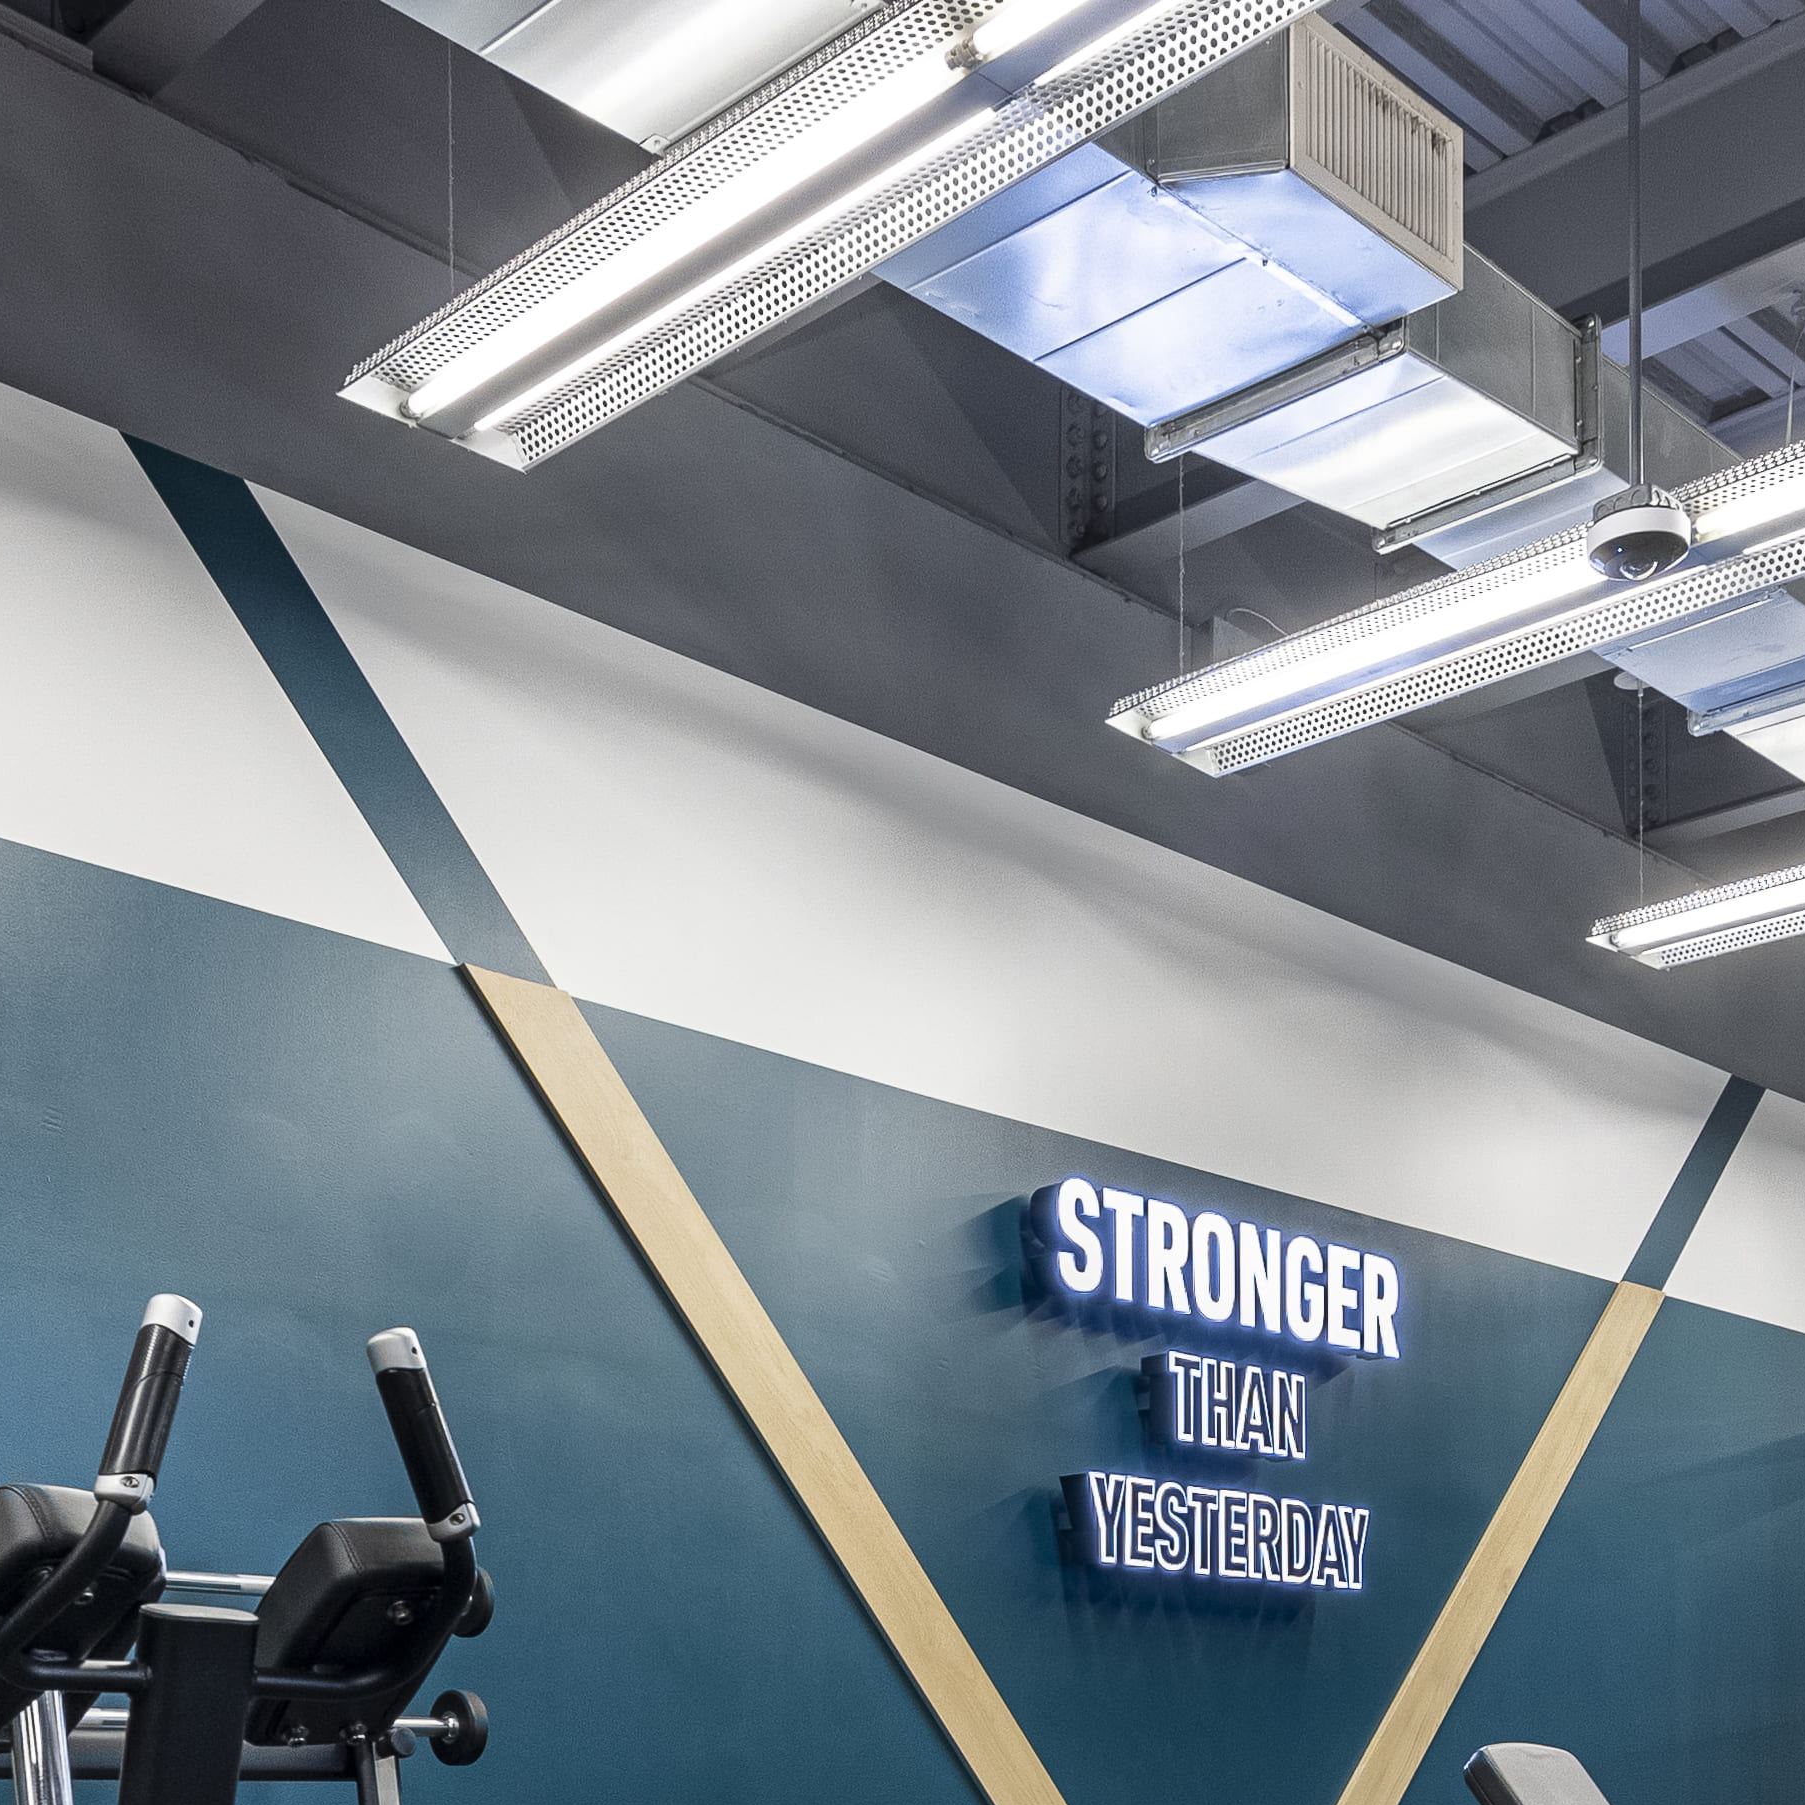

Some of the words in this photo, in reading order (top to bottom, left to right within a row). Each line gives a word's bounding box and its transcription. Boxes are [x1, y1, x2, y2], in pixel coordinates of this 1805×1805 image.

[1056, 1178, 1400, 1358] STRONGER
[1169, 1350, 1306, 1459] THAN
[1089, 1471, 1370, 1589] YESTERDAY
